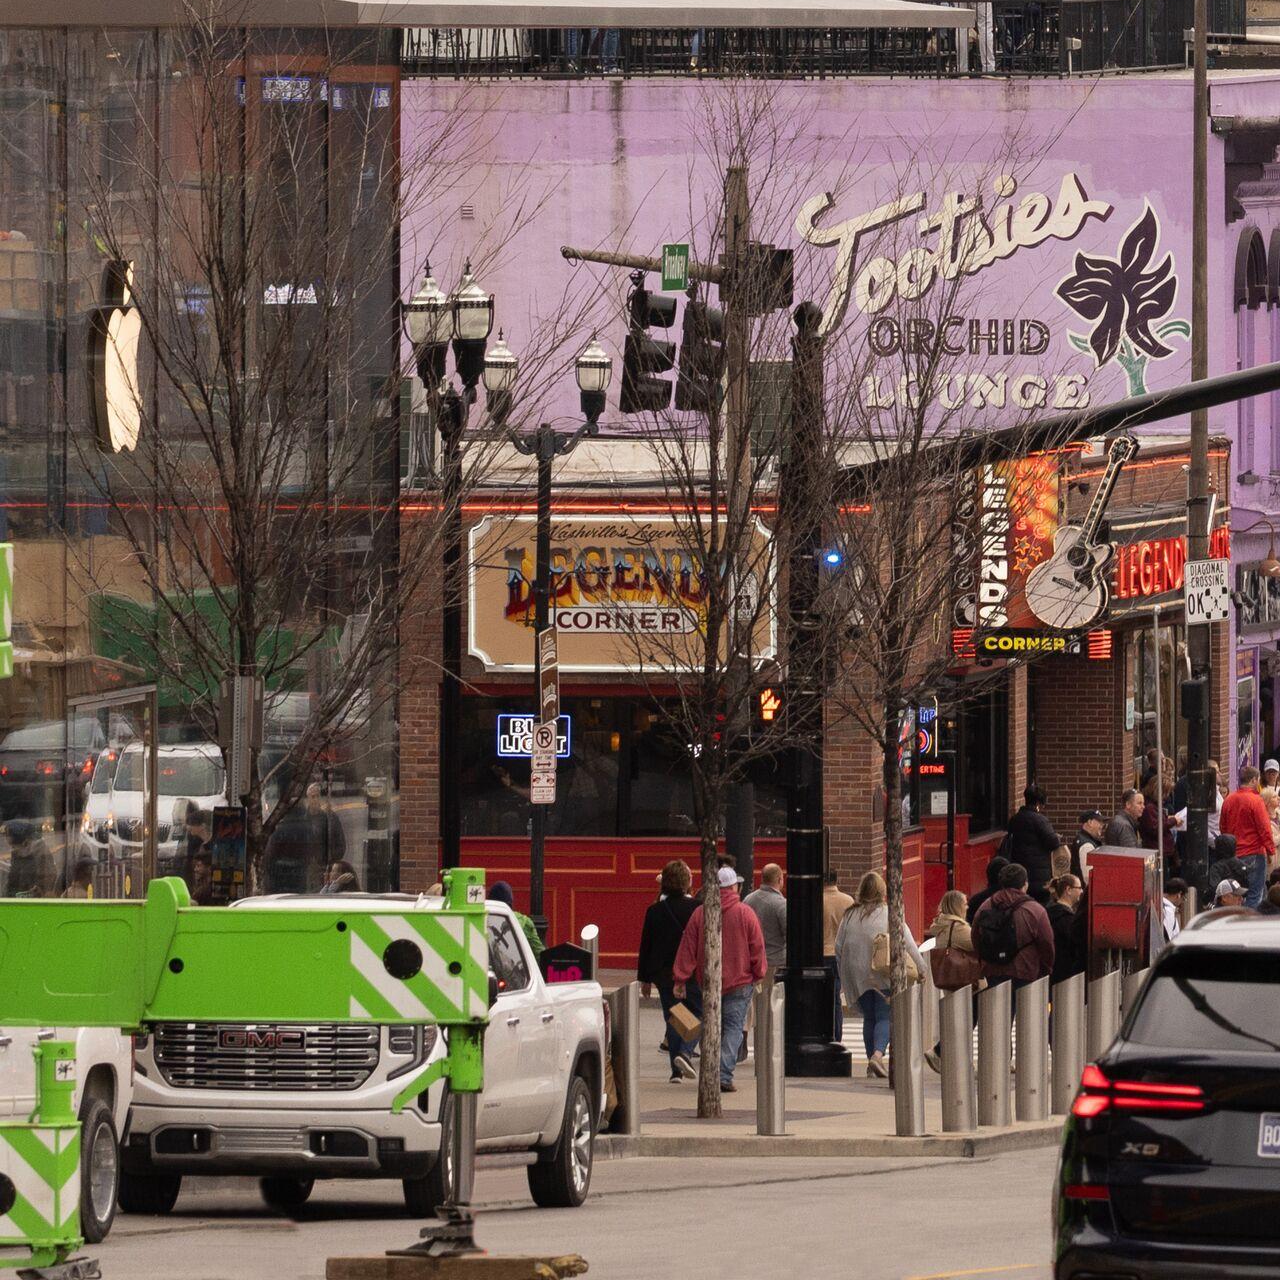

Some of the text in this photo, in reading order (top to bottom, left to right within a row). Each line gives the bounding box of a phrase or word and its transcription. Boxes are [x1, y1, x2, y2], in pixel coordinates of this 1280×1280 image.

[795, 172, 1115, 336] Tootsies
[868, 316, 1051, 358] ORCHID
[863, 372, 1092, 410] LOUNGE
[979, 464, 1009, 628] LEGENDS
[1189, 563, 1225, 575] DIAGONAL
[503, 546, 727, 618] LEGEND
[1190, 575, 1225, 588] CROSSING
[1187, 593, 1204, 616] OK
[556, 610, 681, 630] CORNER
[984, 636, 1066, 652] CORNER
[217, 1028, 306, 1051] GMC
